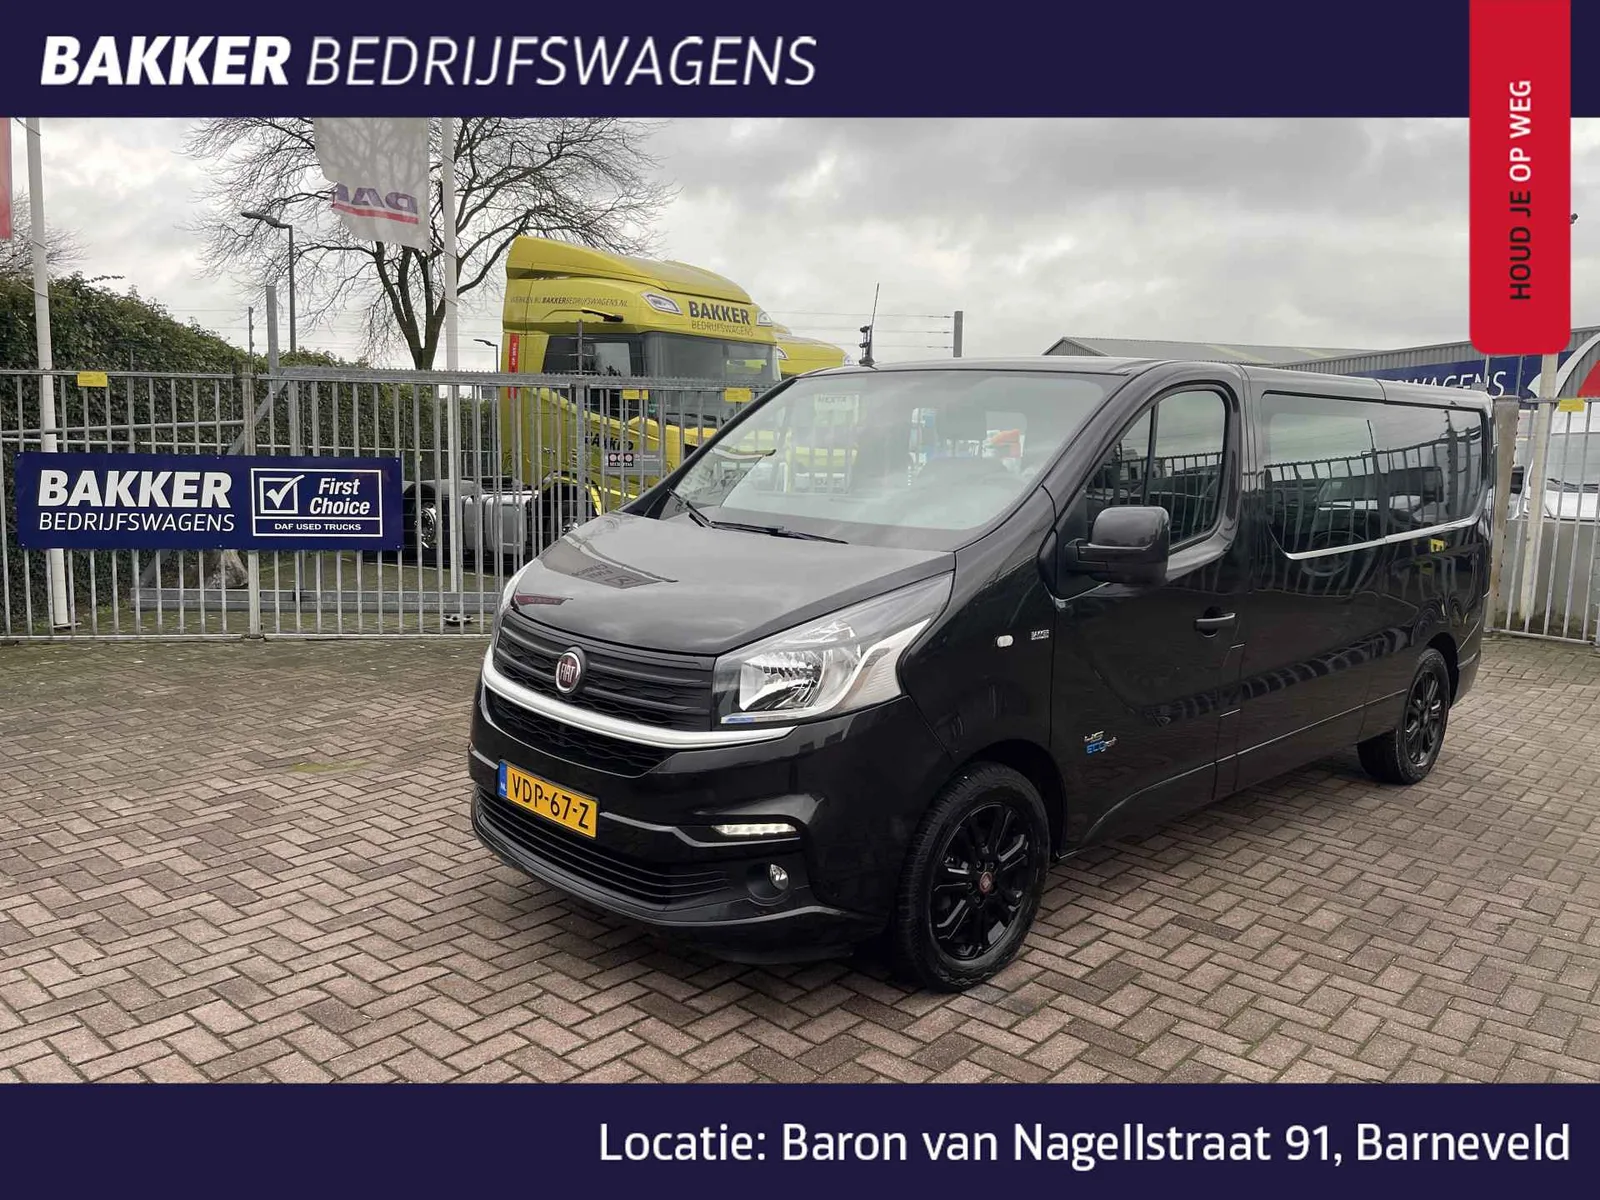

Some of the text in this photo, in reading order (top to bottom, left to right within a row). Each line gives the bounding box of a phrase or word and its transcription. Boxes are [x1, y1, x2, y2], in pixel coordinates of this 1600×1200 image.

[689, 301, 751, 325] BAKKER
[691, 320, 754, 337] BEDRIJFSWAGENS
[37, 469, 232, 508] BAKKER
[318, 477, 361, 495] First
[309, 496, 370, 515] Choice
[39, 512, 235, 532] BEDRIJFSWAGENS
[274, 523, 362, 531] DAF USED TRUCKS
[560, 664, 576, 682] FIAT
[512, 773, 590, 830] VDP-67-Z
